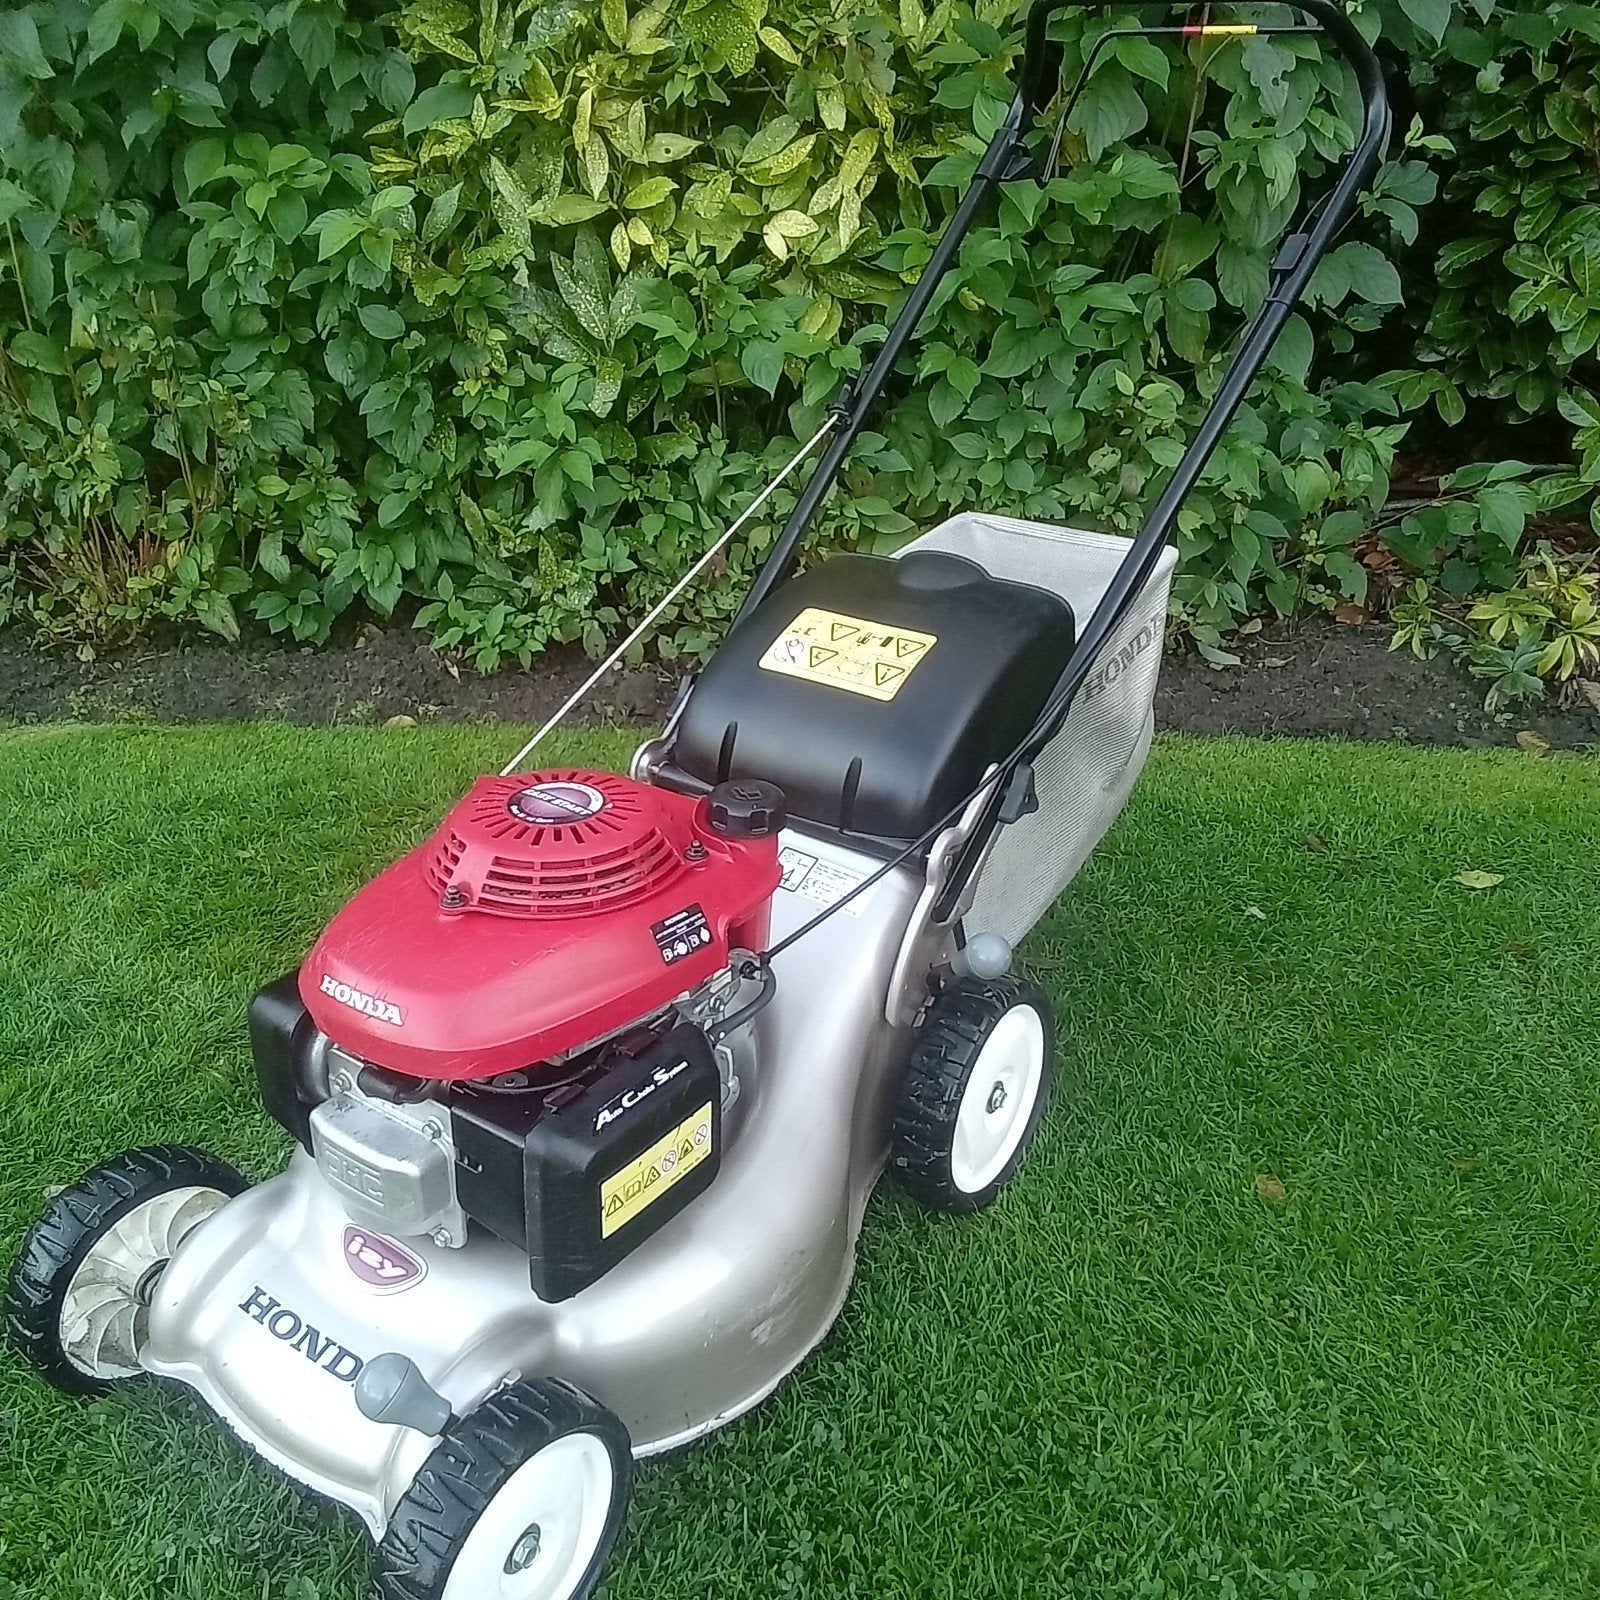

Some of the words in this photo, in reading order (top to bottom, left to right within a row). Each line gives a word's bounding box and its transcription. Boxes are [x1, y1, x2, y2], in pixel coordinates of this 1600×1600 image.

[319, 974, 404, 1026] HONDA
[348, 1235, 409, 1278] izy
[238, 1285, 364, 1388] HOND
